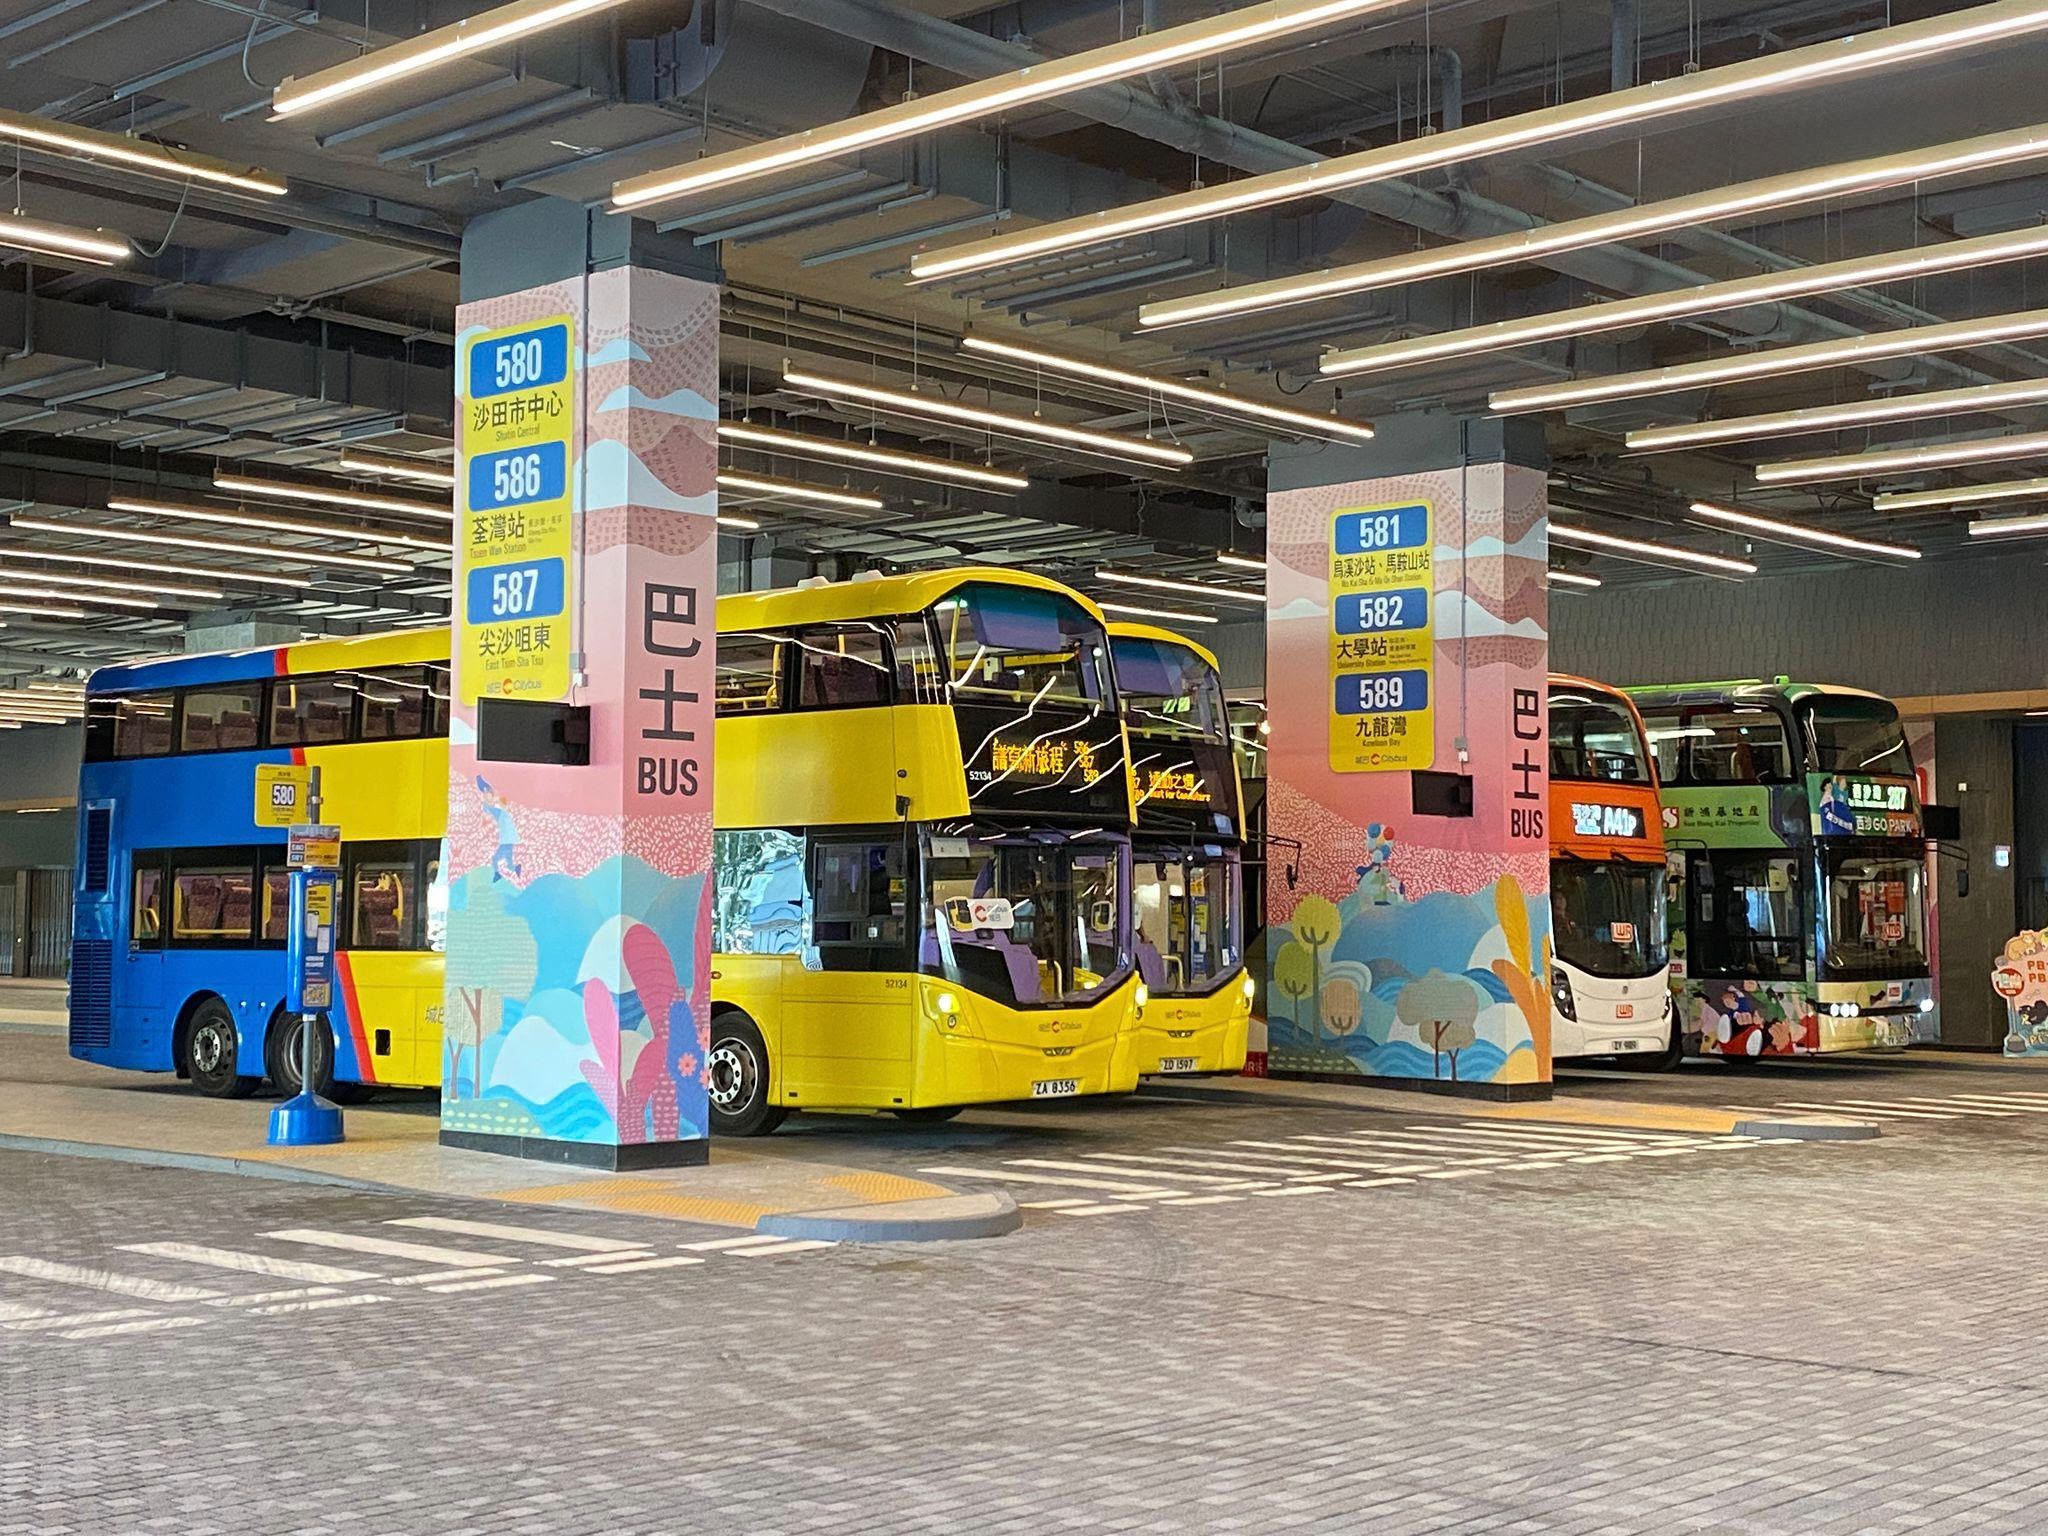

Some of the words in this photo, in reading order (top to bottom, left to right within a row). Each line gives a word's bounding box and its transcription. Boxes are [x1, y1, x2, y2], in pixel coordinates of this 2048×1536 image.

[495, 338, 543, 388] 580
[473, 390, 564, 432] 沙田市中心
[494, 453, 541, 501] 586
[472, 511, 525, 545] 荃灣站
[1359, 514, 1400, 548] 581
[504, 542, 527, 555] Station
[492, 569, 539, 616] 587
[1359, 595, 1404, 629] 582
[479, 622, 551, 657] 尖沙咀東
[1336, 637, 1387, 660] 大學站
[639, 582, 702, 741] 巴士
[1359, 676, 1404, 710] 589
[1355, 715, 1407, 738] 九龍灣
[1512, 688, 1542, 800] 巴士
[637, 757, 698, 797] BUS
[969, 769, 993, 782] 52134
[272, 784, 296, 806] 580
[1510, 808, 1544, 839] BUS
[884, 978, 908, 989] 52134
[1035, 1081, 1048, 1095] ZA
[1051, 1079, 1077, 1094] 8356
